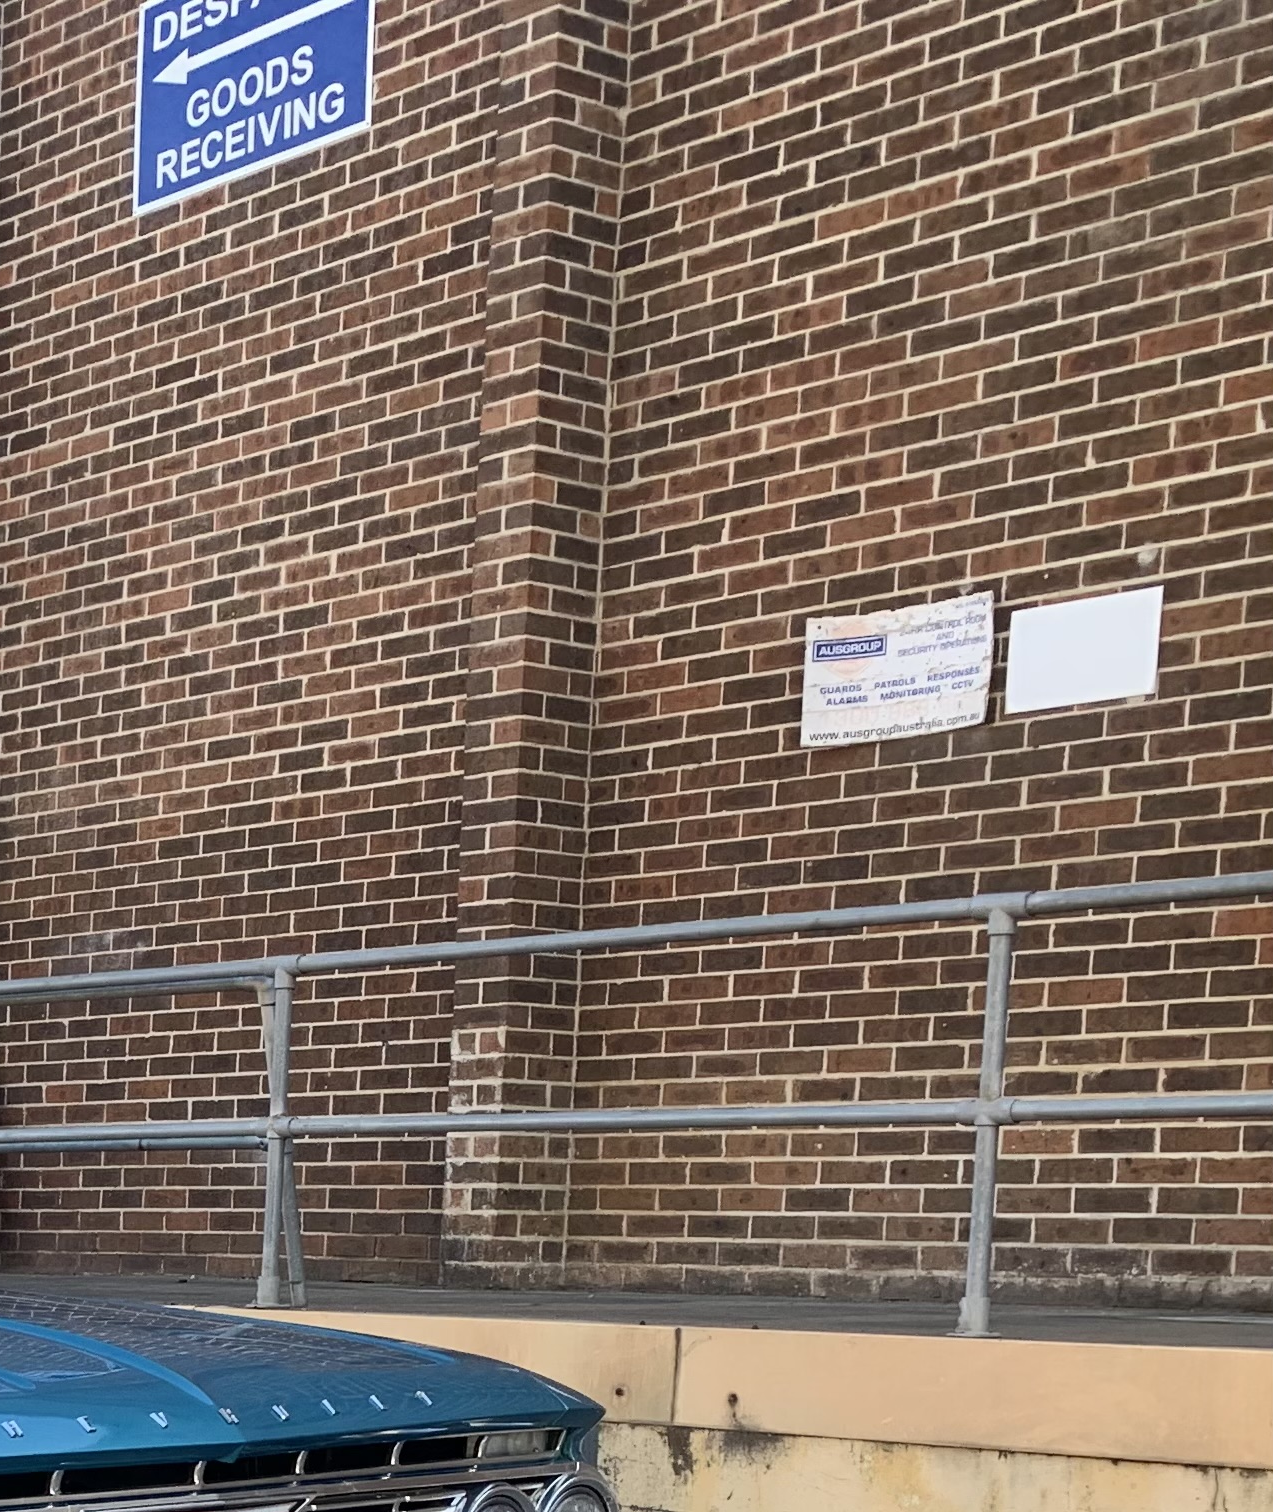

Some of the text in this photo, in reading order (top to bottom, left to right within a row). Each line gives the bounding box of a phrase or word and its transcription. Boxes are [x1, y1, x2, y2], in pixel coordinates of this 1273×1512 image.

[153, 0, 261, 52] DES
[186, 45, 314, 127] GOODS
[156, 82, 345, 189] RECEIVING
[818, 640, 882, 656] AUSGROUP
[936, 630, 955, 641] AND
[897, 644, 938, 657] SECURITY
[819, 665, 981, 695] GUARDS PATROLS RESPONSES
[825, 679, 974, 706] ALARMS MONITORING CCTV
